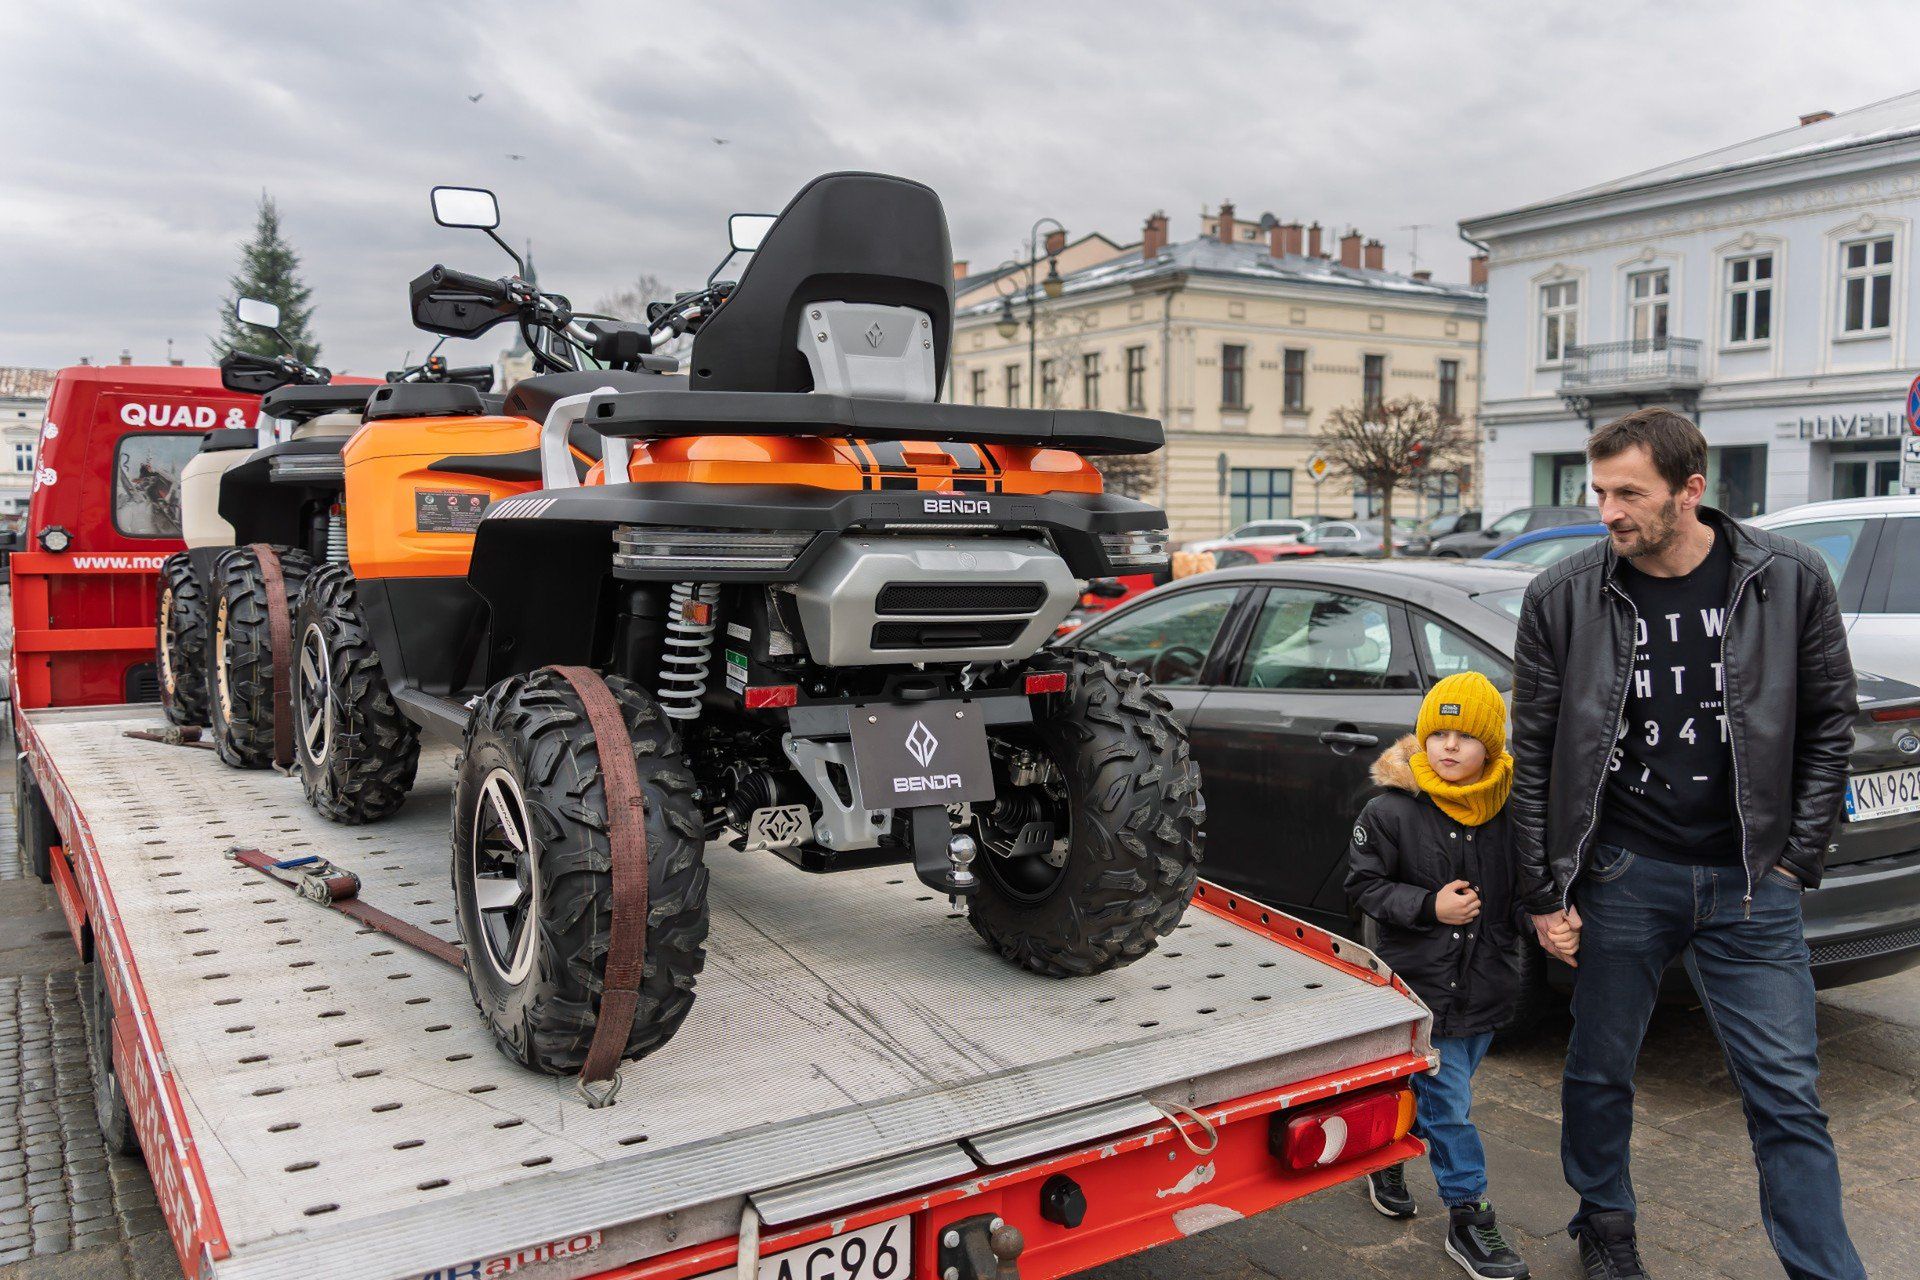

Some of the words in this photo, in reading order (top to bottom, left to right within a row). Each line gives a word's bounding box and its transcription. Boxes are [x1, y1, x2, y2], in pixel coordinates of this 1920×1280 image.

[120, 403, 217, 428] QUAD
[224, 408, 247, 430] &
[923, 499, 991, 514] BENDA
[73, 555, 170, 569] www.mo
[1665, 613, 1680, 642] T
[1700, 608, 1725, 637] W
[1634, 669, 1652, 698] H
[1670, 666, 1686, 694] T
[1644, 720, 1660, 747] 3
[1679, 717, 1697, 745] 4
[893, 773, 962, 793] BENDA
[1854, 776, 1885, 810] KN
